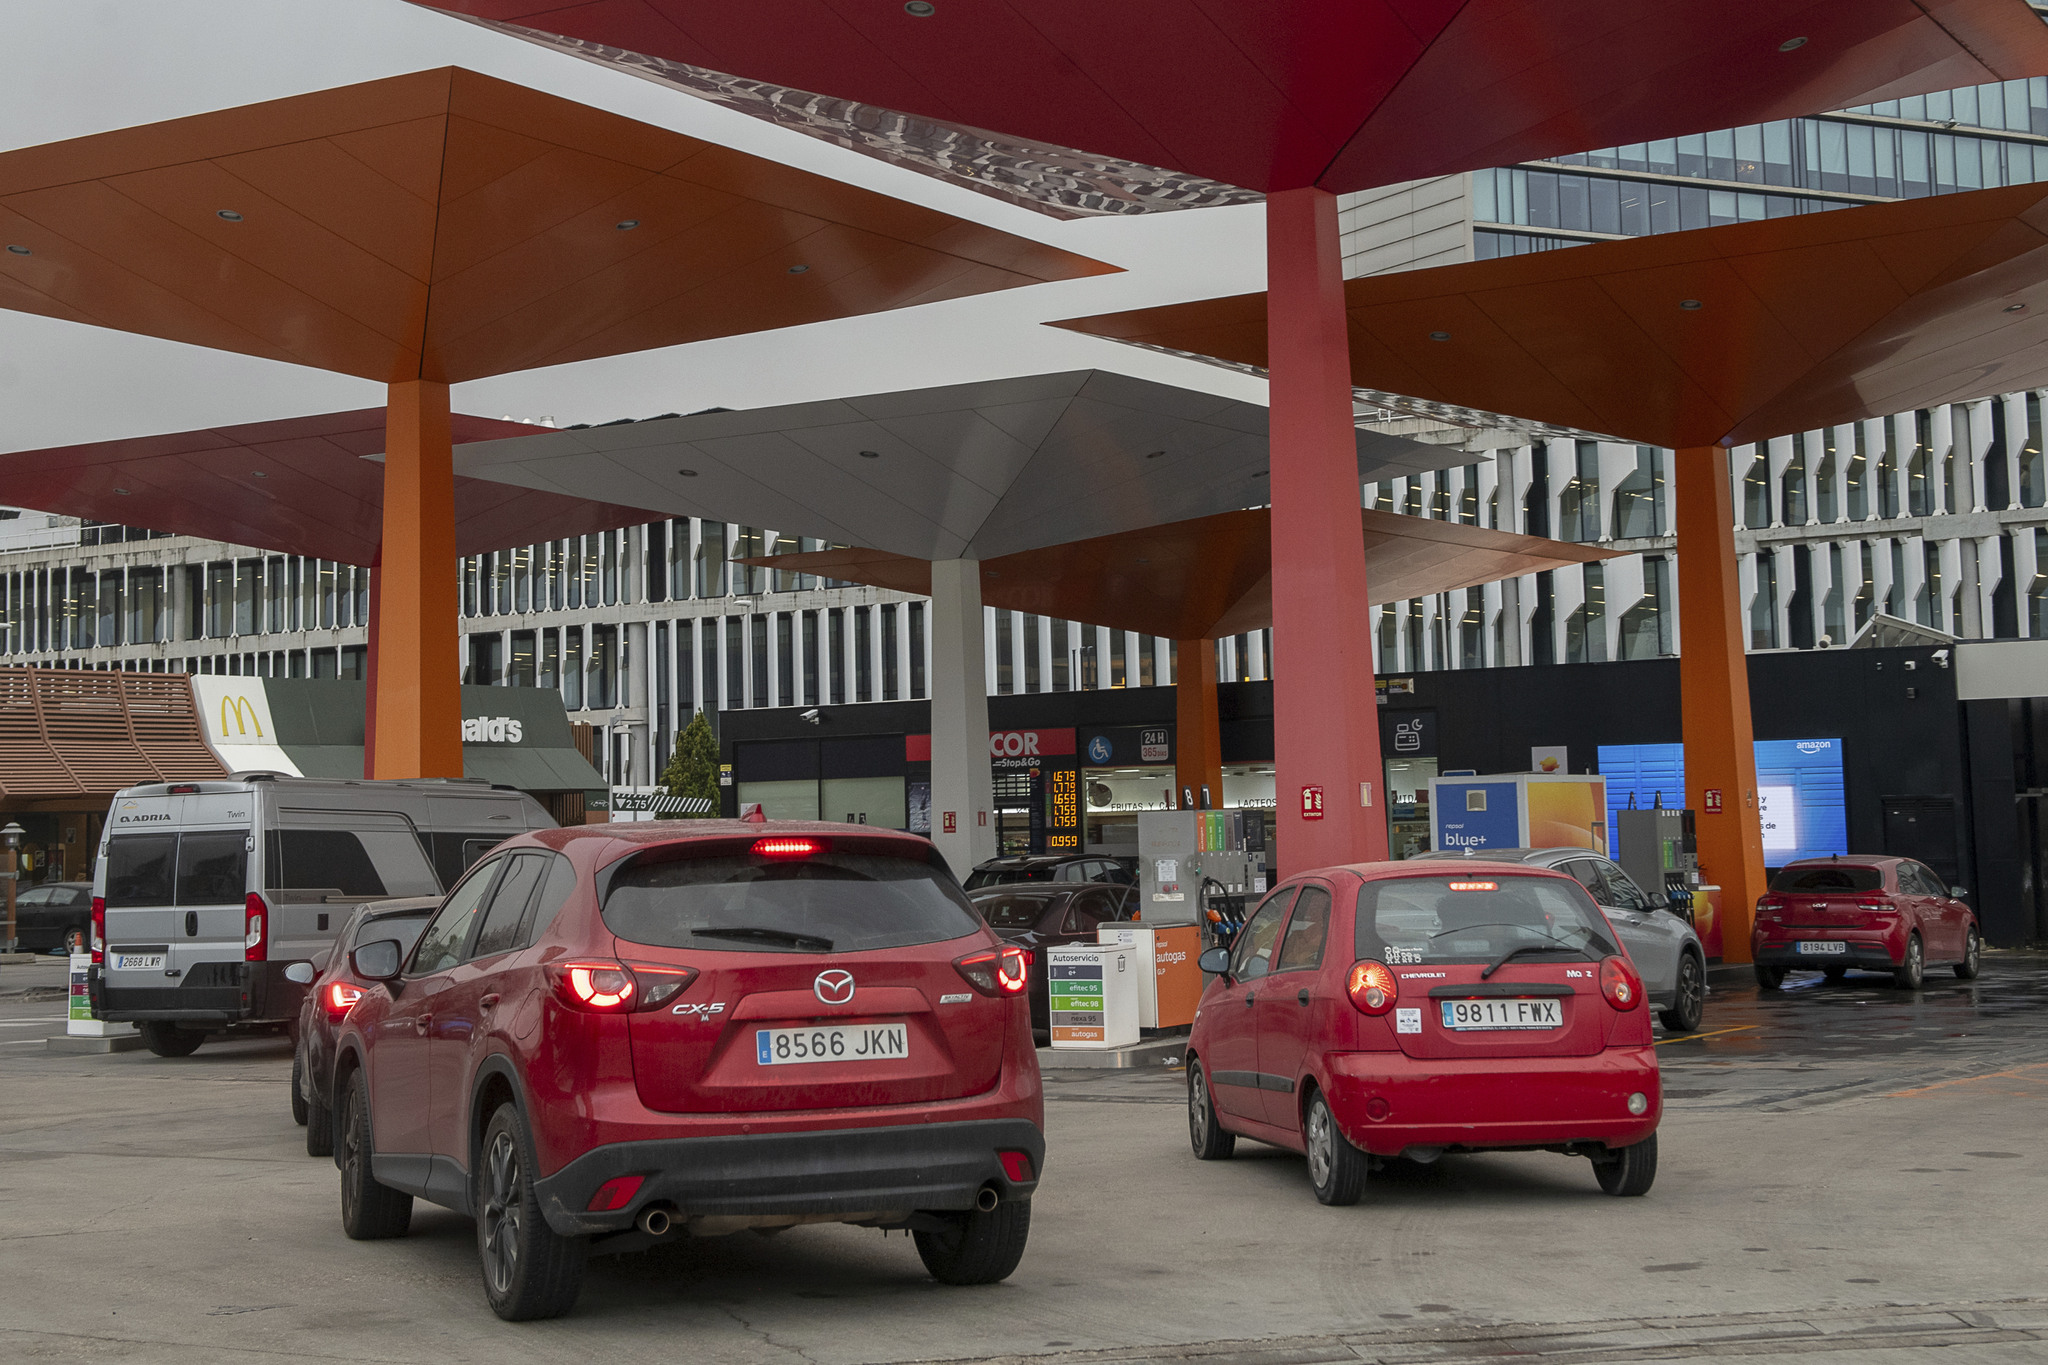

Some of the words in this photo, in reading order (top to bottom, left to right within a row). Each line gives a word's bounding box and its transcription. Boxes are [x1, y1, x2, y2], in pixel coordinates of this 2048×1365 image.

[1145, 732, 1156, 744] 24
[1158, 732, 1165, 743] H
[1796, 741, 1831, 749] amazon
[1143, 747, 1157, 757] 365
[1002, 757, 1041, 768] Stop&Go
[1185, 789, 1194, 805] 8
[1203, 788, 1210, 804] 7
[626, 800, 647, 809] 2.75
[1111, 803, 1144, 812] FRUTAS
[1237, 799, 1277, 808] LACTEOS
[132, 813, 171, 822] ADRIA
[227, 811, 245, 819] Twin
[1445, 833, 1487, 846] blue+
[1803, 943, 1825, 951] 8194
[1827, 943, 1844, 951] LVB
[123, 957, 143, 967] 2668
[1052, 954, 1099, 962] Autoservicio
[1156, 951, 1187, 964] autogas
[672, 1003, 726, 1015] CX-5
[1455, 1003, 1508, 1022] 9811
[1518, 1003, 1556, 1022] FWX
[1071, 1031, 1098, 1039] autogas
[775, 1032, 845, 1059] 8566
[855, 1029, 904, 1055] JKN
